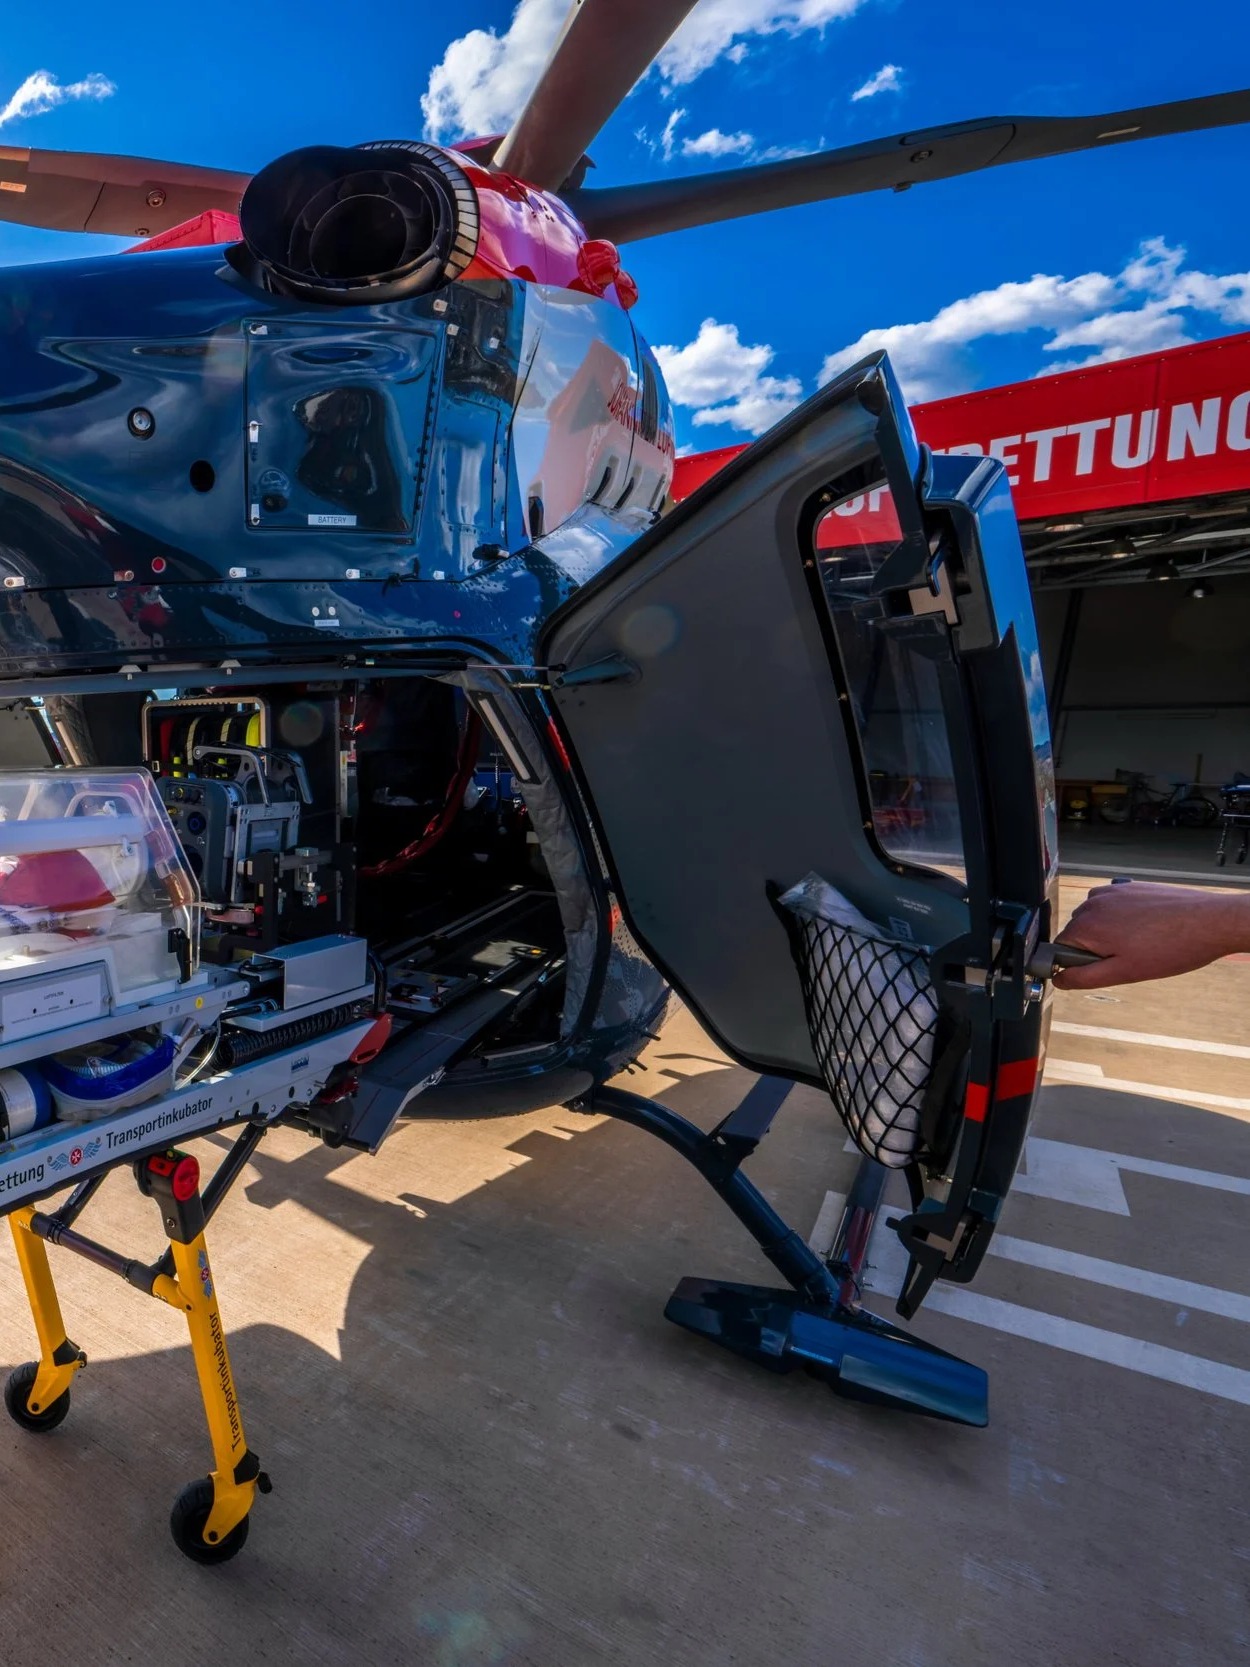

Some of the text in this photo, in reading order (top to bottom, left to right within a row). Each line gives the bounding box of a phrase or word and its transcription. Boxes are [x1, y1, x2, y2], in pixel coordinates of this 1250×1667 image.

[317, 515, 347, 525] BATTERY
[105, 1095, 214, 1149] Transportinkubator
[208, 1311, 242, 1453] Transportinkubator
